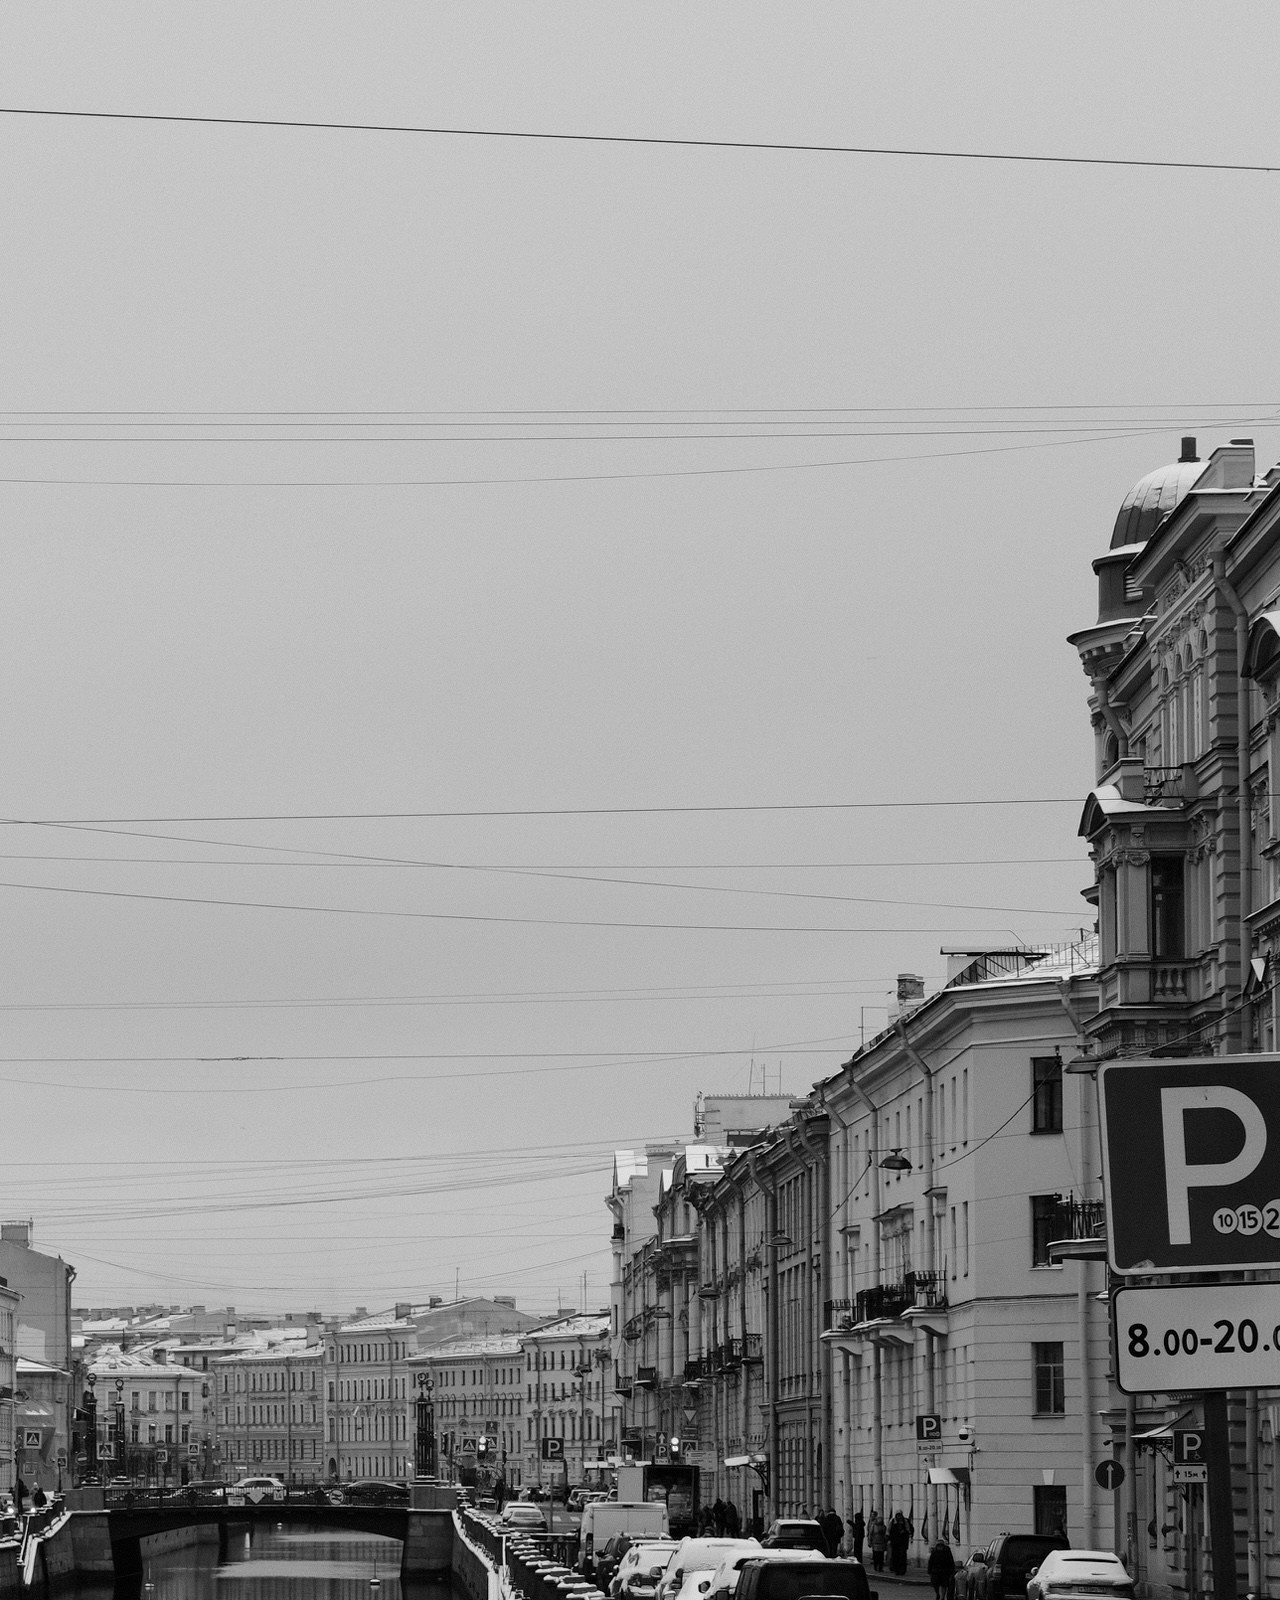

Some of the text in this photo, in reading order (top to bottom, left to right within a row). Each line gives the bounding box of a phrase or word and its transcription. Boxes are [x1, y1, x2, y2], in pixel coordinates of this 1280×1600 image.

[1160, 1085, 1267, 1245] P
[1217, 1207, 1280, 1230] 10 15 2
[923, 1417, 937, 1438] P
[548, 1440, 560, 1458] P
[1183, 1433, 1202, 1460] P
